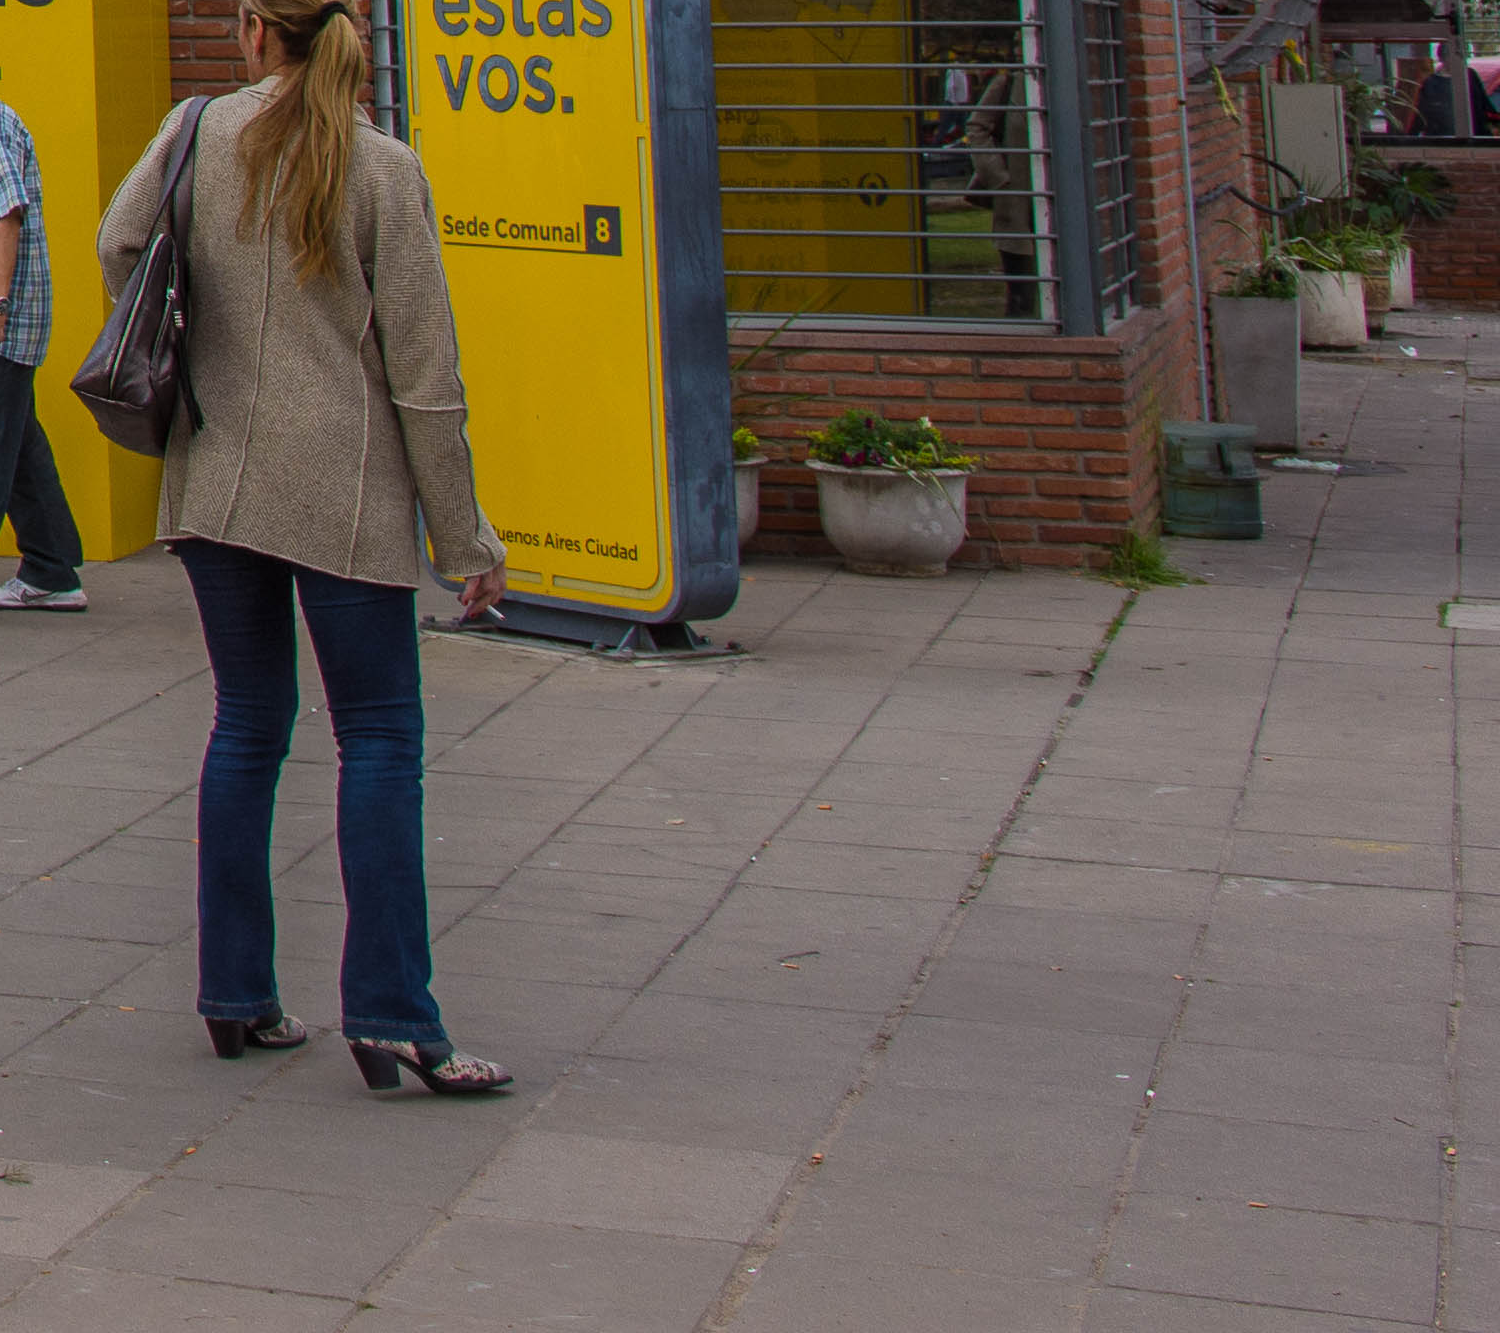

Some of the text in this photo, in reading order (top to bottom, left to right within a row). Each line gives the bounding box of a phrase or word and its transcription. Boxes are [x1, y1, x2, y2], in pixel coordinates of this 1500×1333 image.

[435, 53, 575, 114] vos.
[442, 214, 611, 244] Sede Comunal 8
[544, 532, 581, 554] Aires
[585, 537, 639, 562] Ciudad
